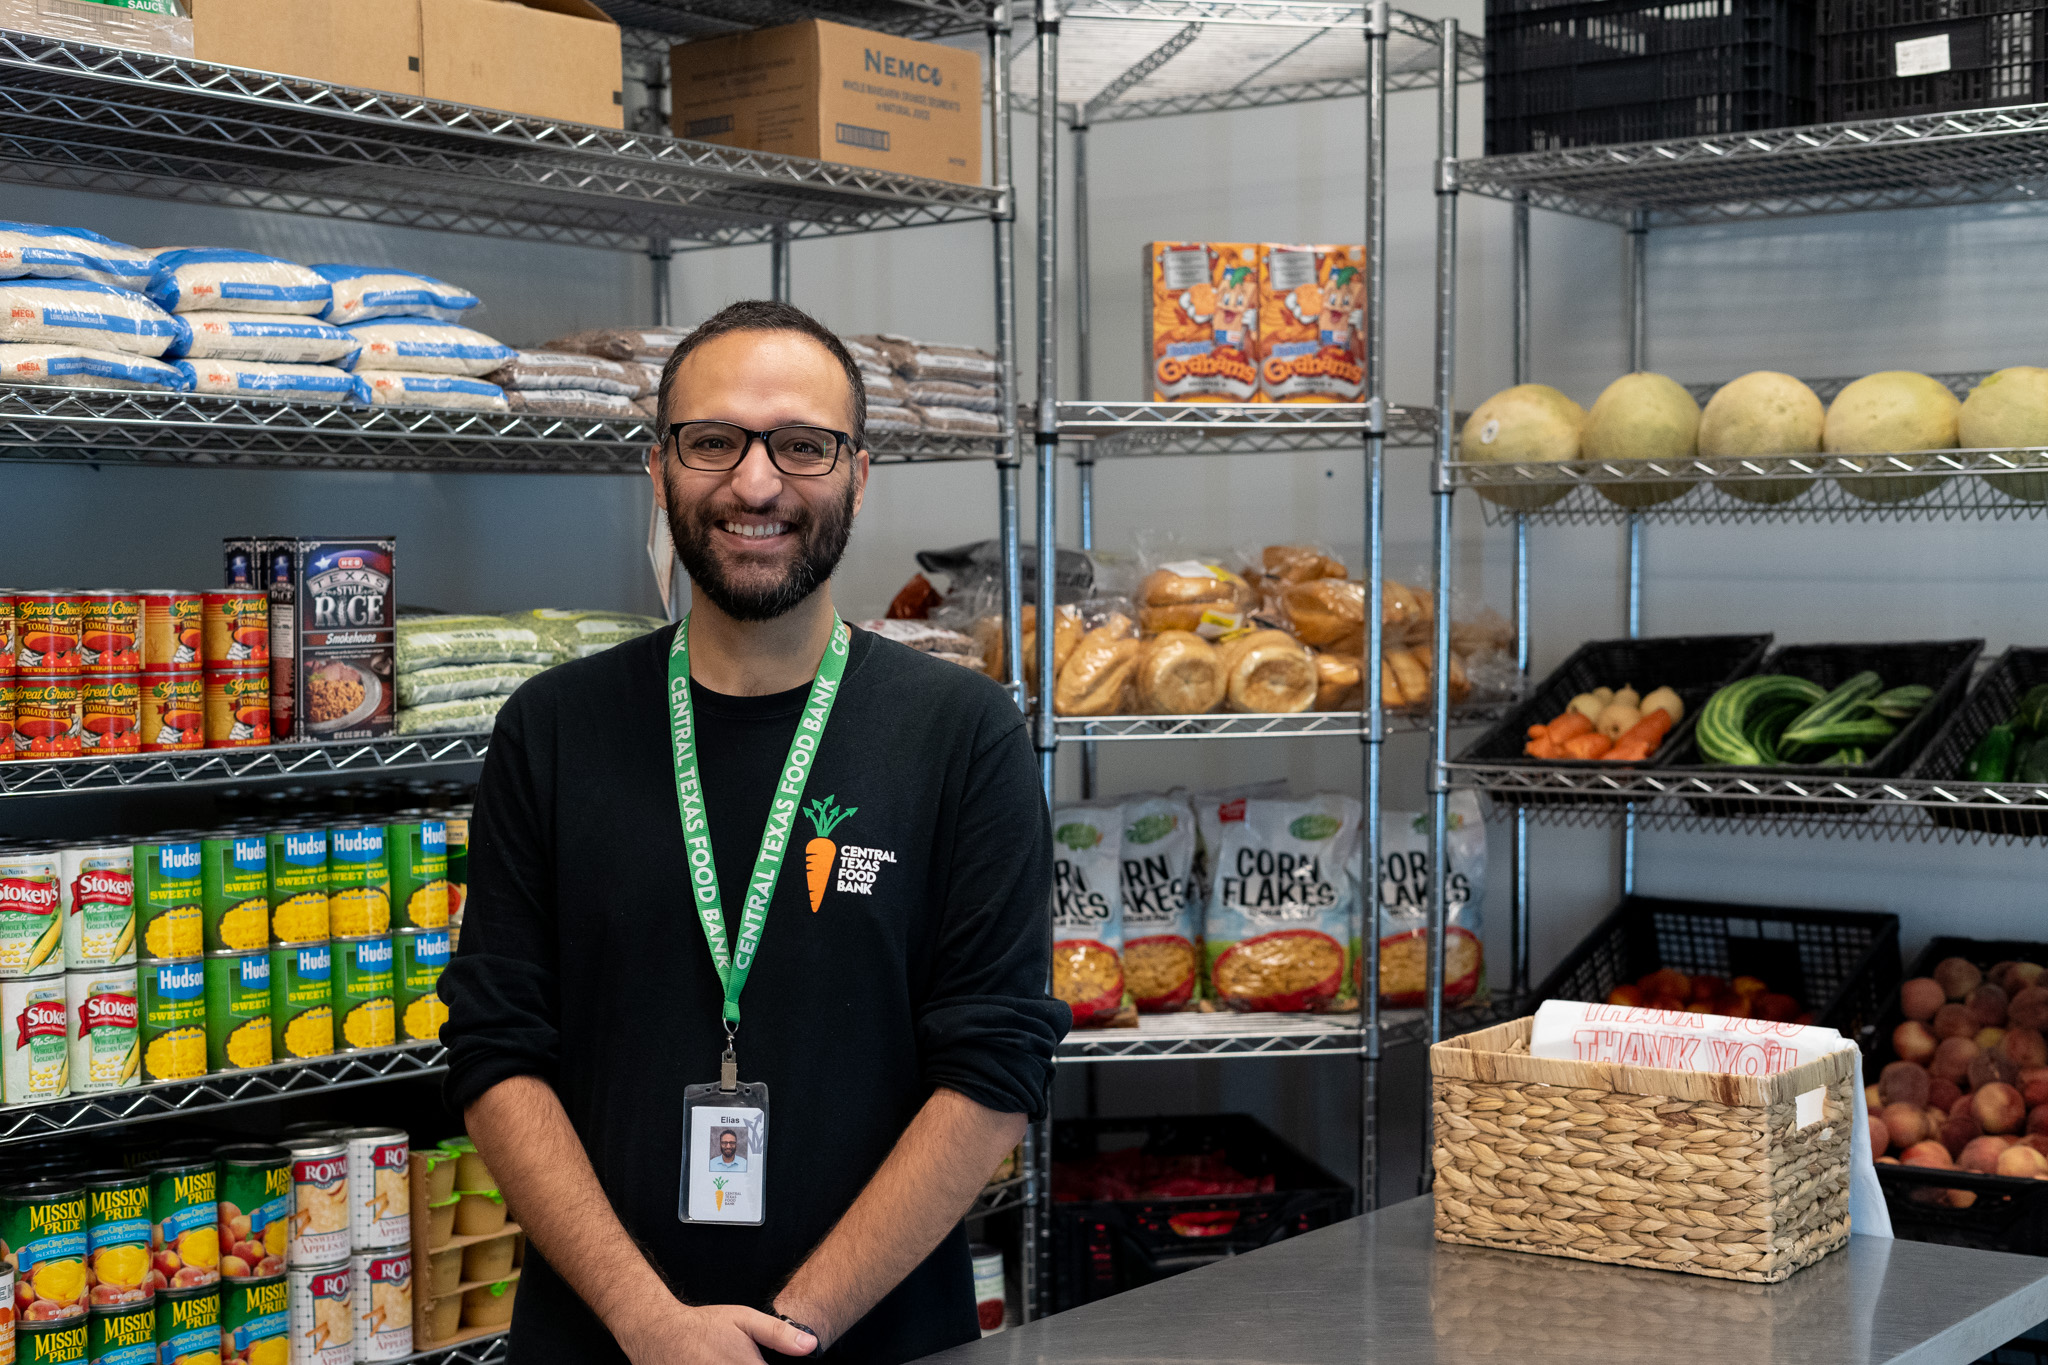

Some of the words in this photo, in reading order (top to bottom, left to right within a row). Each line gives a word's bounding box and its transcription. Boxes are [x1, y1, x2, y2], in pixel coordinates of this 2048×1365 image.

[128, 1, 165, 13] SAUCE
[17, 363, 41, 373] OMEGA
[1157, 355, 1256, 385] Grahams
[1263, 355, 1362, 385] Grahams
[313, 570, 386, 589] TEXAS
[336, 586, 363, 595] STYLE
[19, 601, 55, 619] Great
[55, 601, 80, 616] Choice
[81, 601, 110, 619] Great
[111, 601, 138, 615] Choice
[228, 598, 259, 616] Great
[315, 595, 385, 627] RICE
[27, 623, 59, 632] TOMATO
[60, 626, 77, 634] SAUCE
[84, 622, 116, 632] TOMATO
[116, 624, 134, 633] SAUCE
[325, 632, 377, 645] Smokehouse
[15, 685, 43, 704] Great
[44, 685, 76, 700] Choice
[81, 683, 110, 702] Great
[111, 682, 138, 697] Choice
[158, 680, 191, 699] Great
[230, 677, 260, 696] Great
[17, 707, 48, 717] TOMATO
[49, 710, 70, 718] SAUCE
[84, 705, 116, 714] TOMATO
[116, 707, 134, 715] SAUCE
[671, 676, 693, 766] CENTRAL
[679, 766, 704, 832] TEXAS
[736, 869, 775, 970] CENTRAL
[760, 798, 795, 862] TEXAS
[781, 734, 815, 795] FOOD
[803, 675, 836, 732] BANK
[334, 831, 383, 852] Hudson
[840, 845, 897, 863] CENTRAL
[688, 835, 717, 903] FOOD
[840, 856, 880, 872] TEXAS
[1237, 848, 1319, 883] CORN
[276, 875, 315, 886] SWEET
[838, 867, 877, 883] FOOD
[150, 889, 190, 900] SWEET
[224, 881, 261, 892] SWEET
[836, 880, 873, 895] BANK
[1223, 876, 1335, 907] FLAKES
[21, 921, 43, 930] KERNEL
[23, 930, 40, 938] CORN
[702, 908, 730, 969] BANK
[289, 989, 325, 1001] SWEET
[347, 981, 385, 993] SWEET
[88, 999, 137, 1019] Stokely
[231, 999, 266, 1012] SWEET
[27, 1007, 66, 1026] Stoke
[148, 1010, 190, 1021] SWEET
[1573, 1030, 1700, 1072] THANK
[1713, 1039, 1798, 1076] YOU
[721, 1116, 740, 1124] Elias
[91, 1186, 149, 1218] MISSION
[29, 1198, 86, 1232] MISSION
[105, 1206, 143, 1221] PRIDE
[44, 1220, 81, 1235] PRIDE
[186, 1313, 218, 1329] PRIDE
[118, 1329, 152, 1346] PRIDE
[49, 1346, 84, 1363] PRIDE
